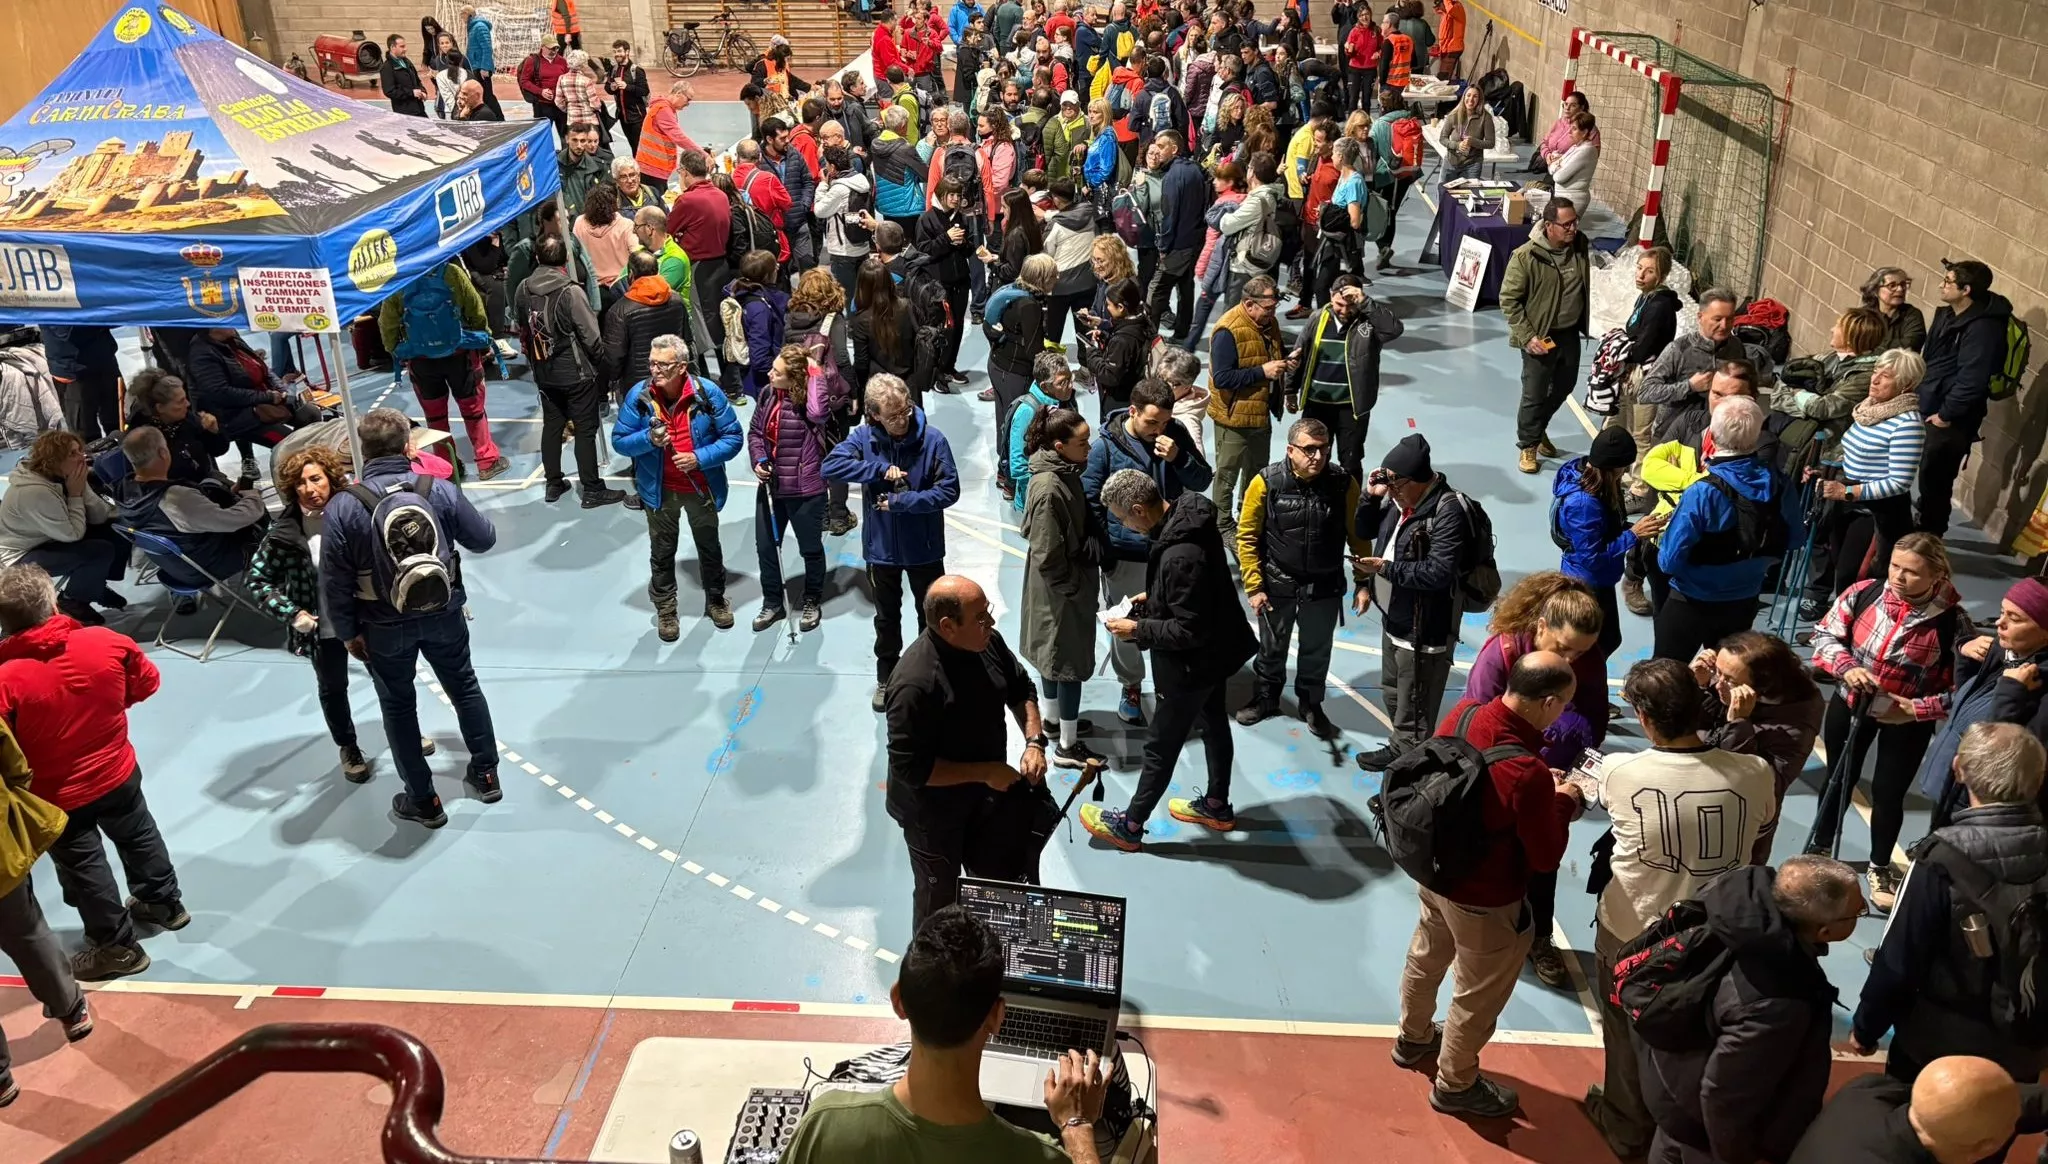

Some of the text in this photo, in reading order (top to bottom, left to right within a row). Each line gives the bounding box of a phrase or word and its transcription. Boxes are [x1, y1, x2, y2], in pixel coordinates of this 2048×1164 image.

[218, 94, 278, 115] Caminata
[232, 99, 312, 129] BAJO LAS
[252, 107, 352, 143] ESTRELLAS
[456, 176, 481, 221] JAB
[3, 248, 63, 291] JAB
[260, 271, 312, 279] ABIERTAS
[243, 279, 327, 288] INSCRIPCIONES
[251, 288, 321, 296] XI CAMINATA
[254, 305, 325, 314] LAS ERMITAS
[265, 297, 311, 305] RUTA DE
[1631, 787, 1747, 877] 10
